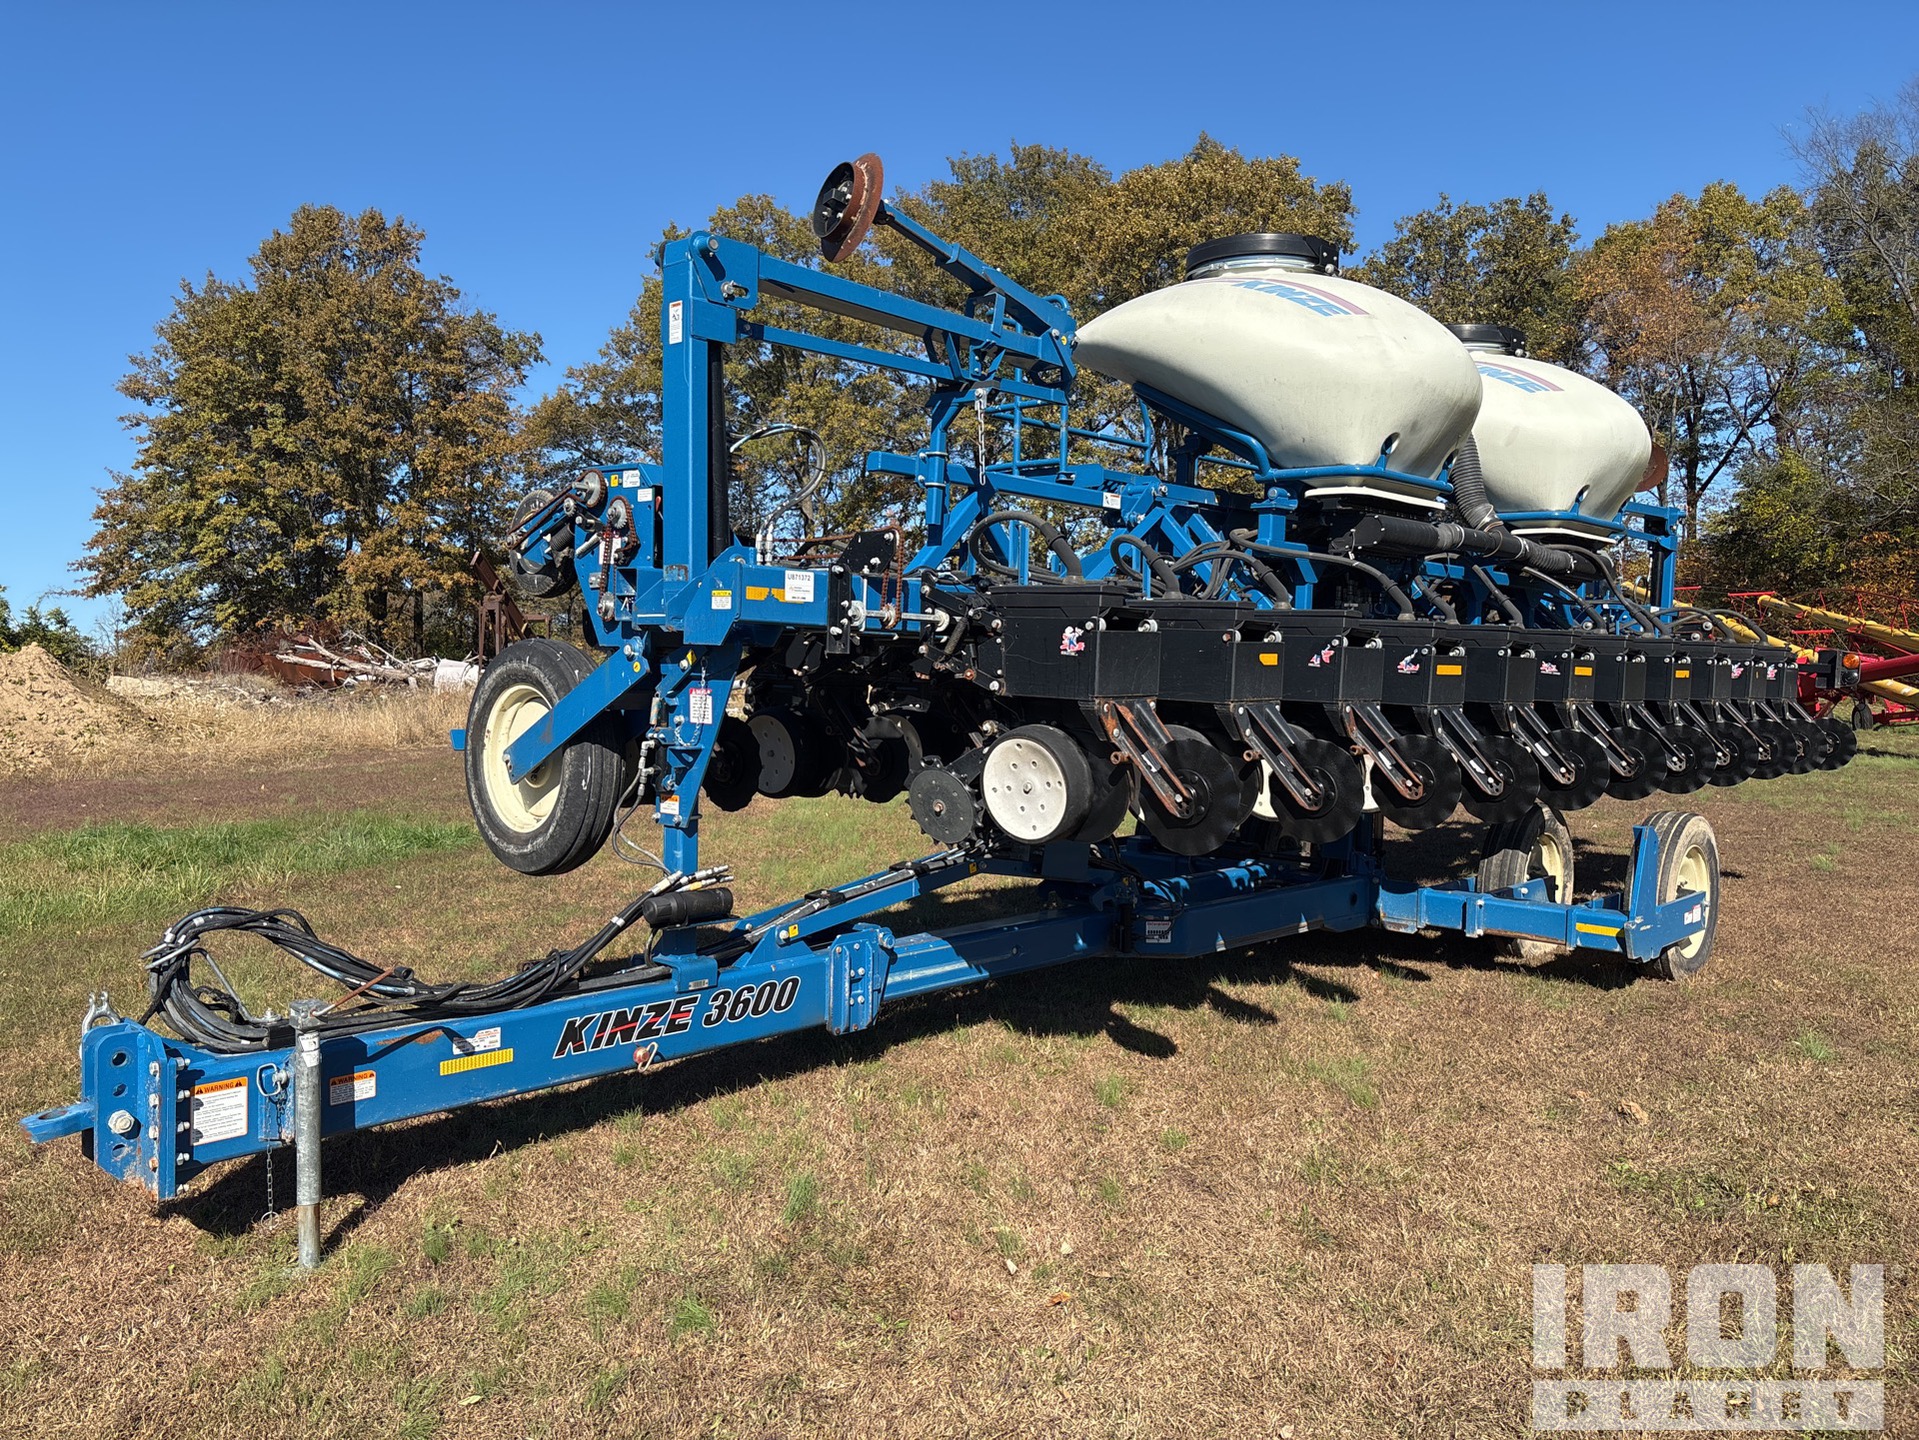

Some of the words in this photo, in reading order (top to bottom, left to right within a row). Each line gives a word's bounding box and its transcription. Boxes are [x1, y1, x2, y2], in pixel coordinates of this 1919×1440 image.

[553, 994, 701, 1059] KINZE
[703, 975, 801, 1029] 3600
[338, 1074, 368, 1084] WARNING
[204, 1082, 234, 1093] WARNING
